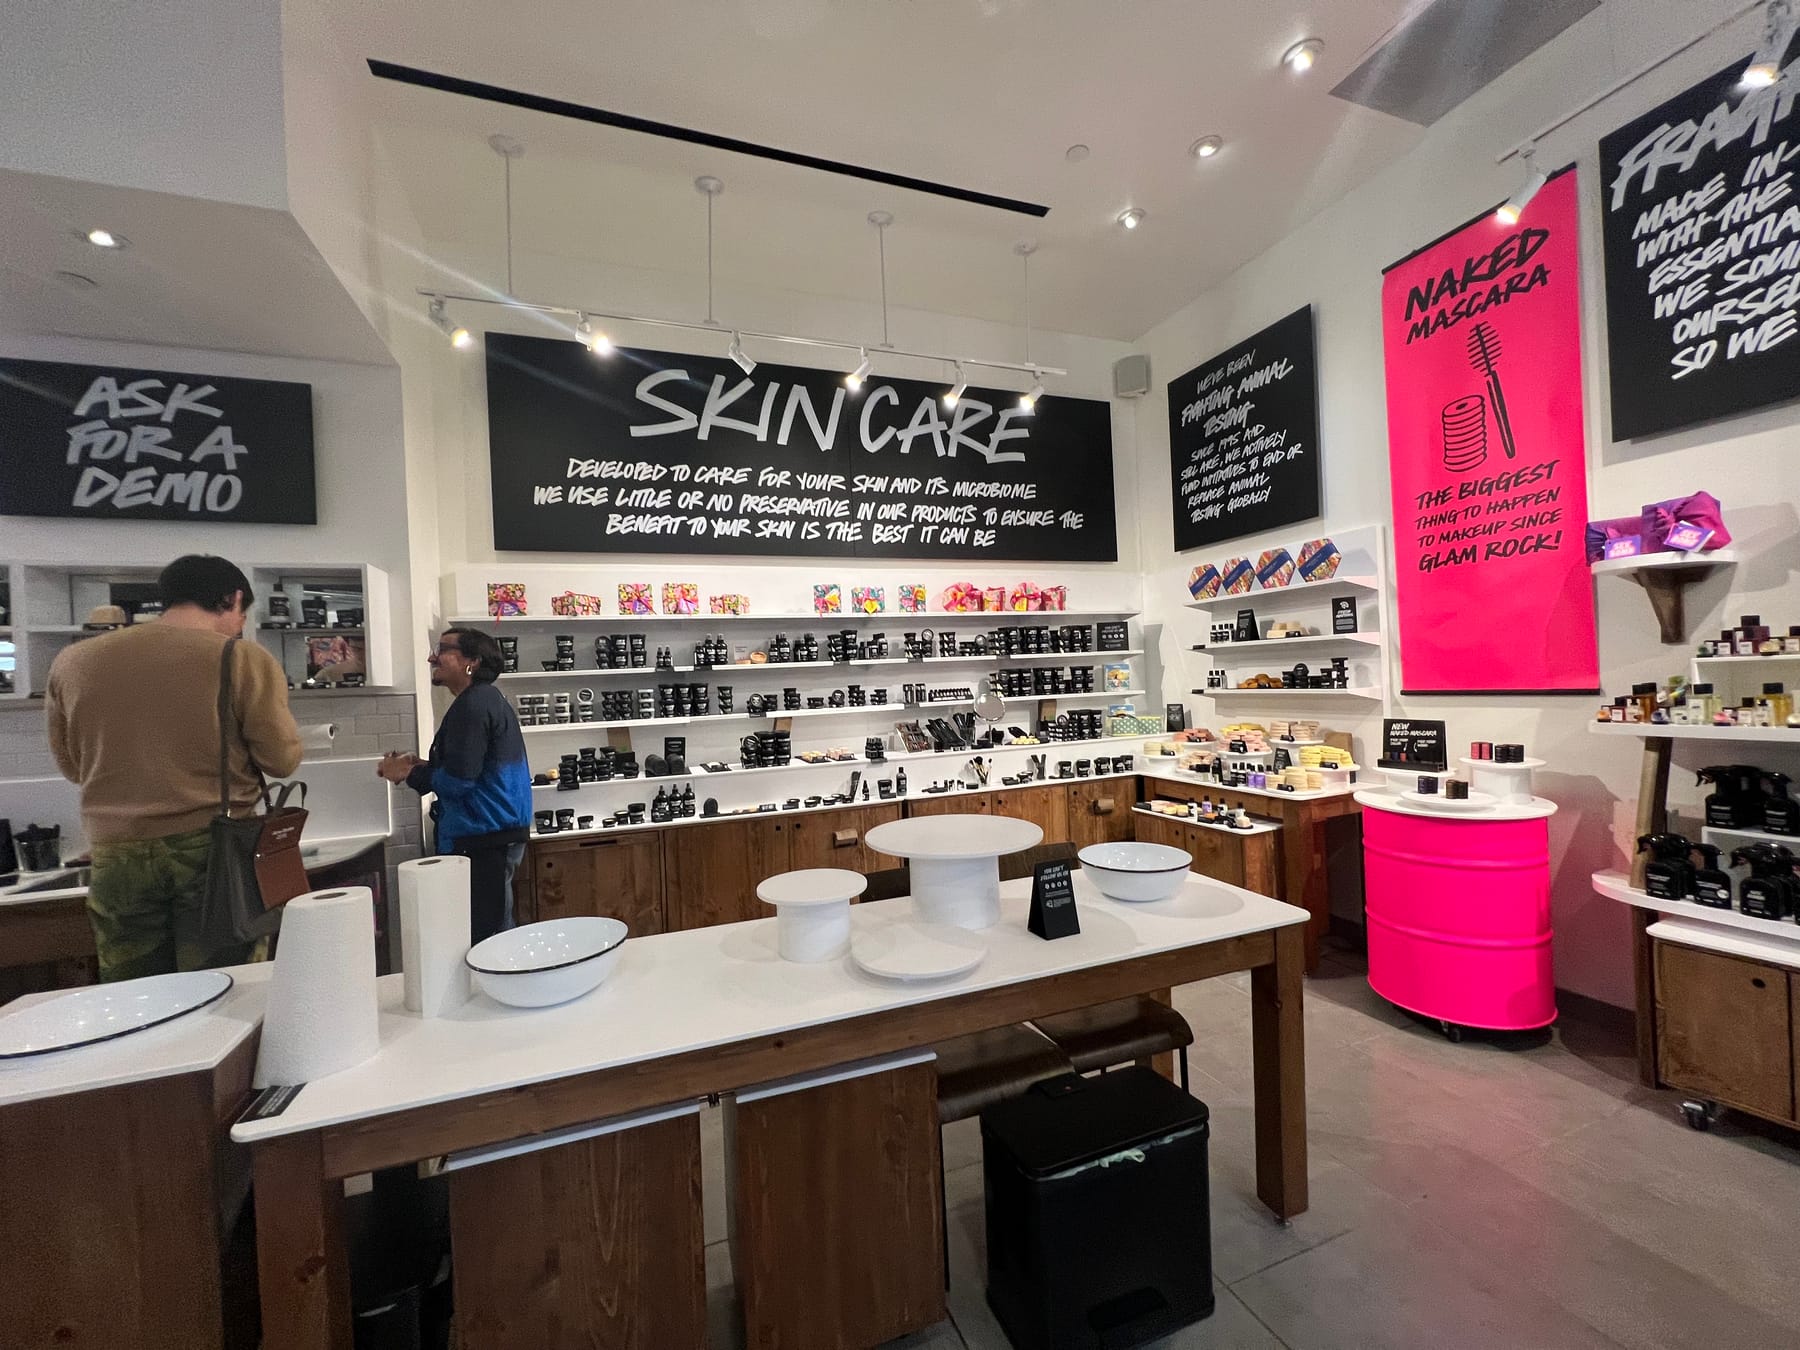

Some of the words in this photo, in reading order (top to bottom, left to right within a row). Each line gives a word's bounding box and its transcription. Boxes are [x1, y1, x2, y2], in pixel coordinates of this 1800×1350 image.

[1632, 172, 1727, 240] MADE
[1637, 212, 1713, 268] WITH
[1713, 171, 1794, 233] THE
[1404, 228, 1550, 321] NAKED
[1654, 273, 1712, 320] WE
[1715, 240, 1800, 296] SOU
[1406, 264, 1551, 345] MASCARA
[1226, 348, 1256, 377] BEEN
[1671, 340, 1718, 380] SO
[1727, 309, 1798, 359] WE
[74, 376, 224, 422] ASK
[1182, 385, 1235, 428] FIGHTING
[1236, 357, 1294, 399] ANIMAL
[629, 368, 847, 451] SKIN
[859, 384, 1036, 464] CARE
[1203, 400, 1256, 438] TESTING
[66, 420, 183, 465] FOR
[190, 426, 248, 470] A
[1191, 442, 1215, 462] SINCE
[1243, 424, 1265, 441] AND
[1225, 446, 1241, 464] WE
[1241, 429, 1287, 458] ACTIVELY
[1248, 456, 1259, 472] TO
[1262, 450, 1285, 467] END
[1287, 443, 1303, 460] OR
[72, 466, 243, 512] DEMO
[566, 458, 668, 482] DEVELOPED
[670, 464, 690, 482] TO
[693, 467, 752, 485] CARE
[758, 466, 793, 488] FOR
[796, 471, 847, 491] YOUR
[852, 474, 889, 492] SKIN
[889, 478, 922, 494] AND
[925, 476, 950, 496] ITS
[952, 481, 1037, 500] MICROBIOME
[1188, 485, 1225, 509] REPLACE
[1228, 472, 1270, 495] ANIMAL
[1415, 486, 1453, 510] THE
[1458, 459, 1561, 500] BIGGEST
[533, 486, 563, 505] WE
[568, 486, 609, 507] USE
[615, 487, 672, 508] LITTLE
[677, 490, 704, 509] OR
[706, 494, 733, 511] NO
[739, 494, 850, 518] PRESERVATIVE
[857, 502, 876, 521] IN
[877, 503, 907, 521] OUR
[911, 504, 978, 524] PRODUCTS
[983, 507, 998, 526] TO
[1000, 509, 1054, 527] ENSURE
[1059, 510, 1084, 530] THE
[1191, 503, 1225, 524] TESTING
[1227, 485, 1272, 514] GLOBALLY
[1415, 509, 1460, 530] THING
[1461, 504, 1481, 521] TO
[1485, 486, 1561, 515] HAPPEN
[606, 513, 688, 535] BENEFIT
[686, 516, 708, 536] TO
[711, 518, 751, 539] YOUR
[755, 520, 796, 539] SKIN
[801, 521, 821, 540] IS
[826, 522, 862, 542] THE
[872, 523, 914, 544] BEST
[920, 526, 938, 544] IT
[939, 527, 969, 544] CAN
[973, 529, 996, 548] BE
[1417, 534, 1435, 549] TO
[1438, 520, 1507, 545] MAKEUP
[1510, 508, 1563, 532] SINCE
[1418, 544, 1478, 573] GLAM
[1484, 530, 1562, 561] ROCK!
